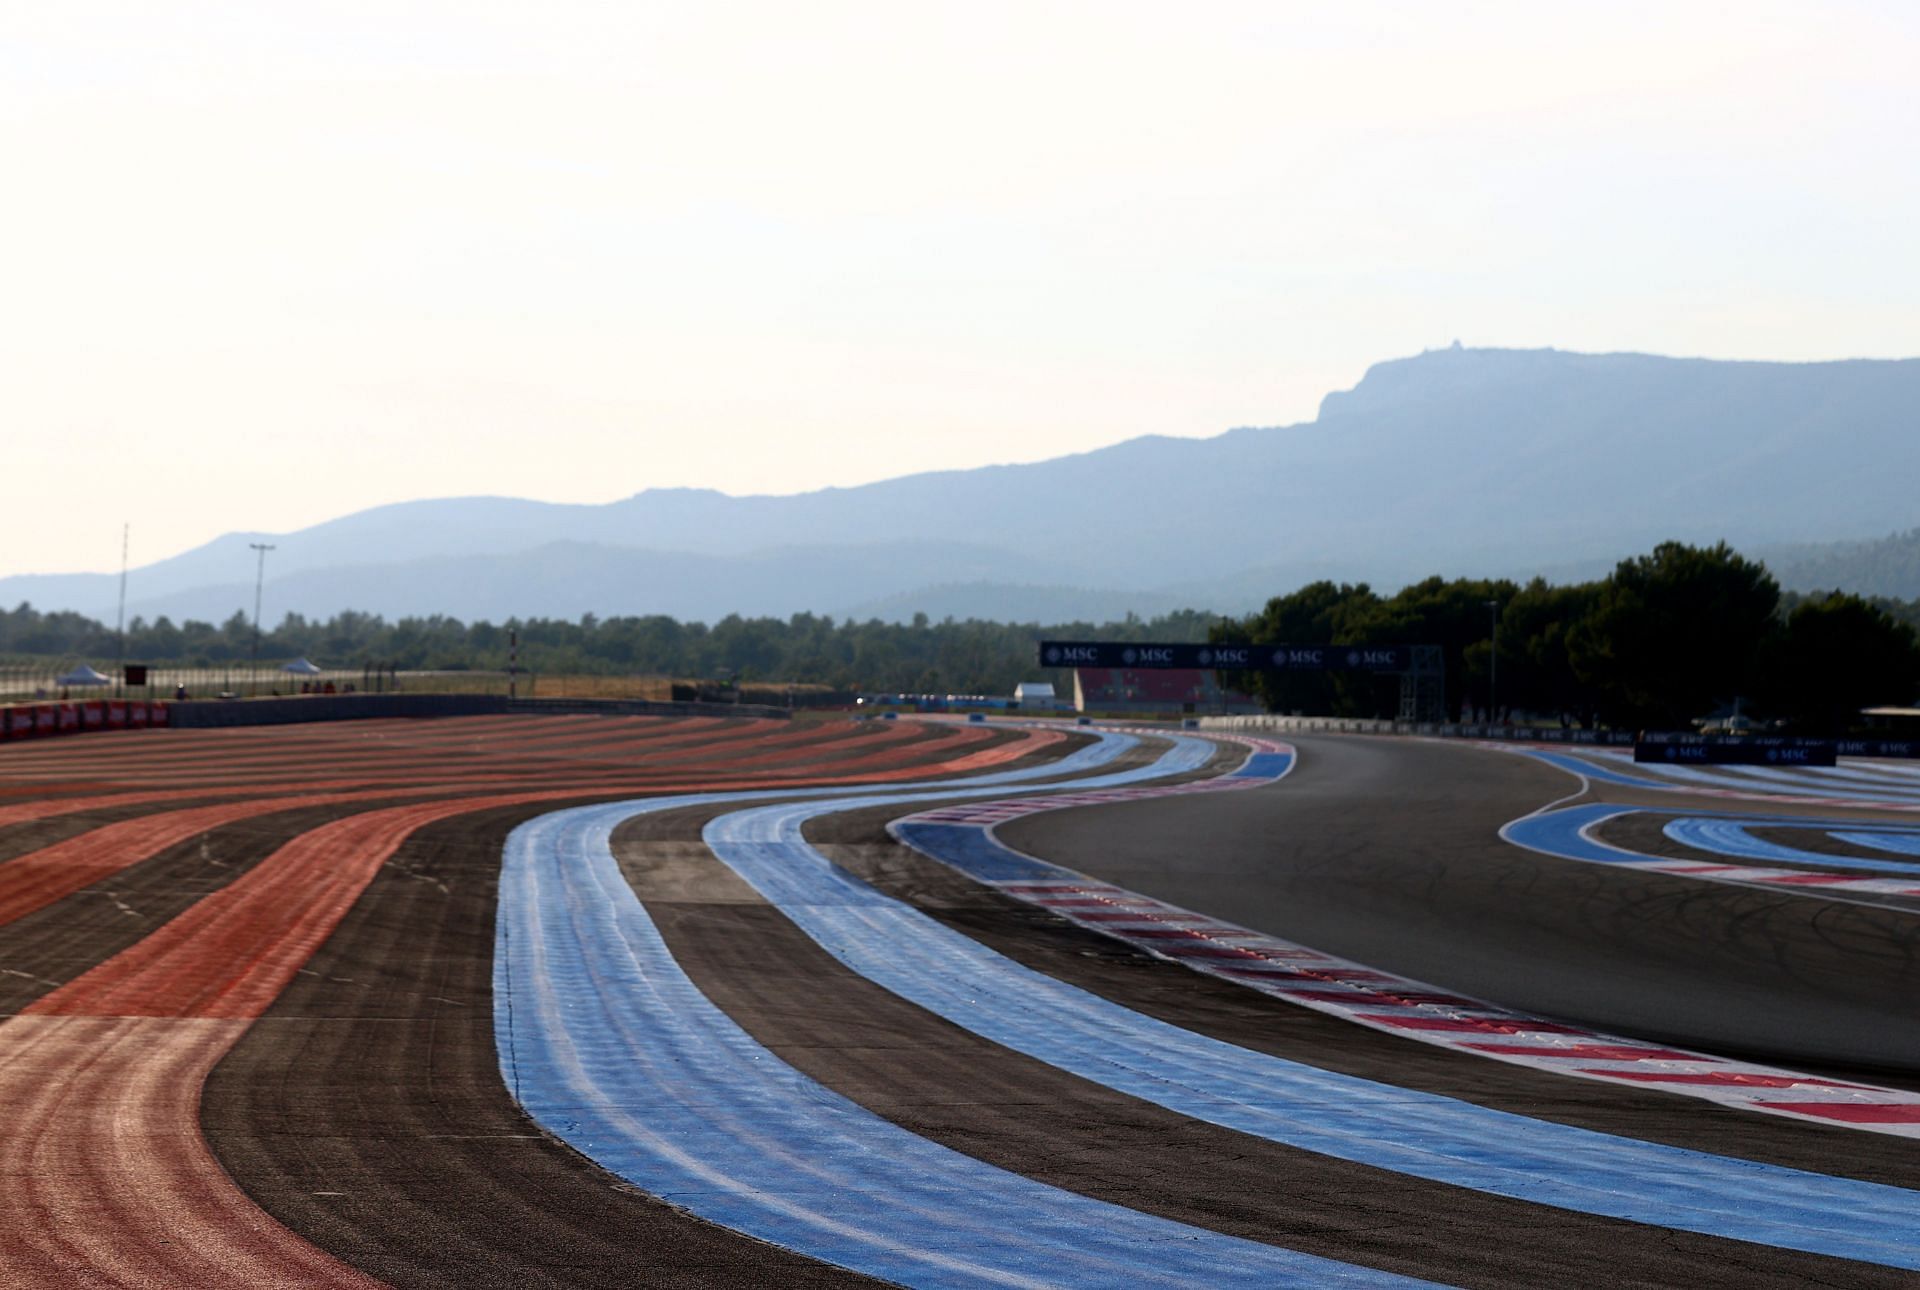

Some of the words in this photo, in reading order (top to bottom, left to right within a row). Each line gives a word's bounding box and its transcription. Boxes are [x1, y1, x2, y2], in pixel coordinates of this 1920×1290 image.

[1063, 646, 1098, 660] MSC
[1139, 647, 1174, 661] MSC
[1214, 648, 1249, 662] MSC
[1288, 649, 1323, 663] MSC
[1363, 649, 1397, 664] MSC
